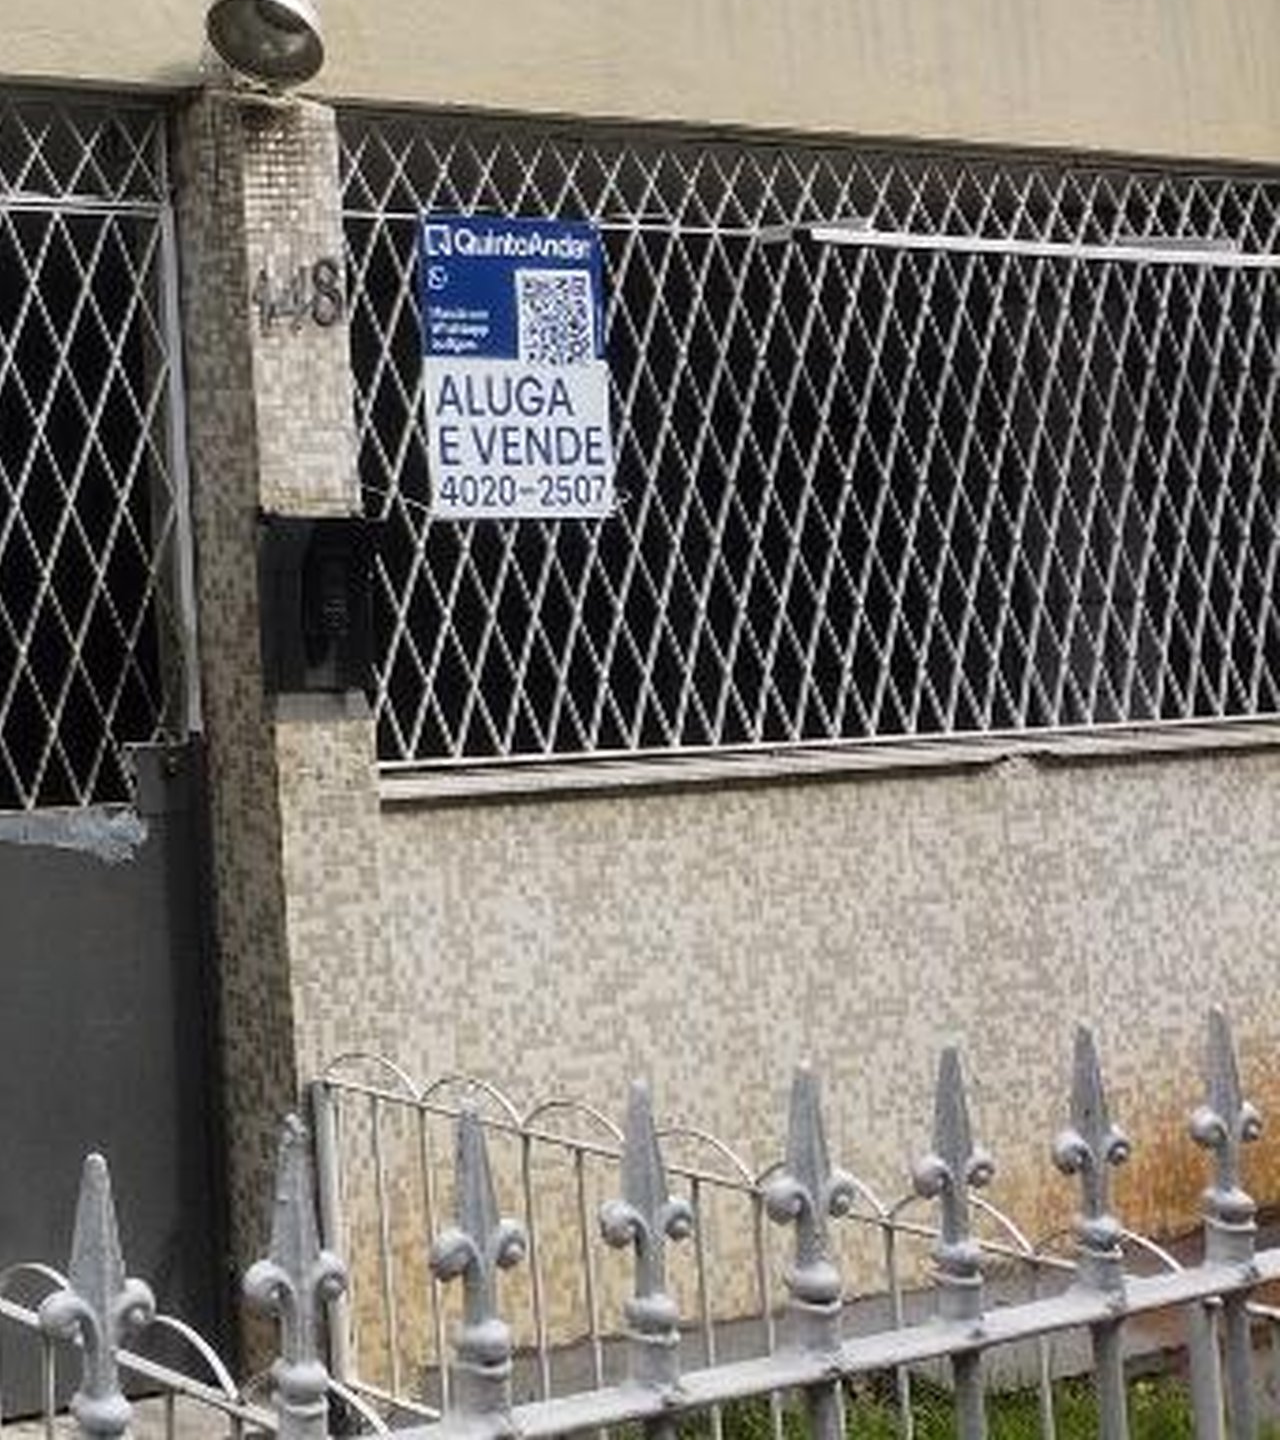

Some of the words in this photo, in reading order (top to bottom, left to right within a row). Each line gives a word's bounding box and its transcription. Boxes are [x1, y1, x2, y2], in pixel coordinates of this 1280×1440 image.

[435, 374, 575, 417] ALUGA
[439, 425, 461, 466] E
[470, 425, 606, 466] VENDE
[440, 474, 607, 507] 4020-2507
